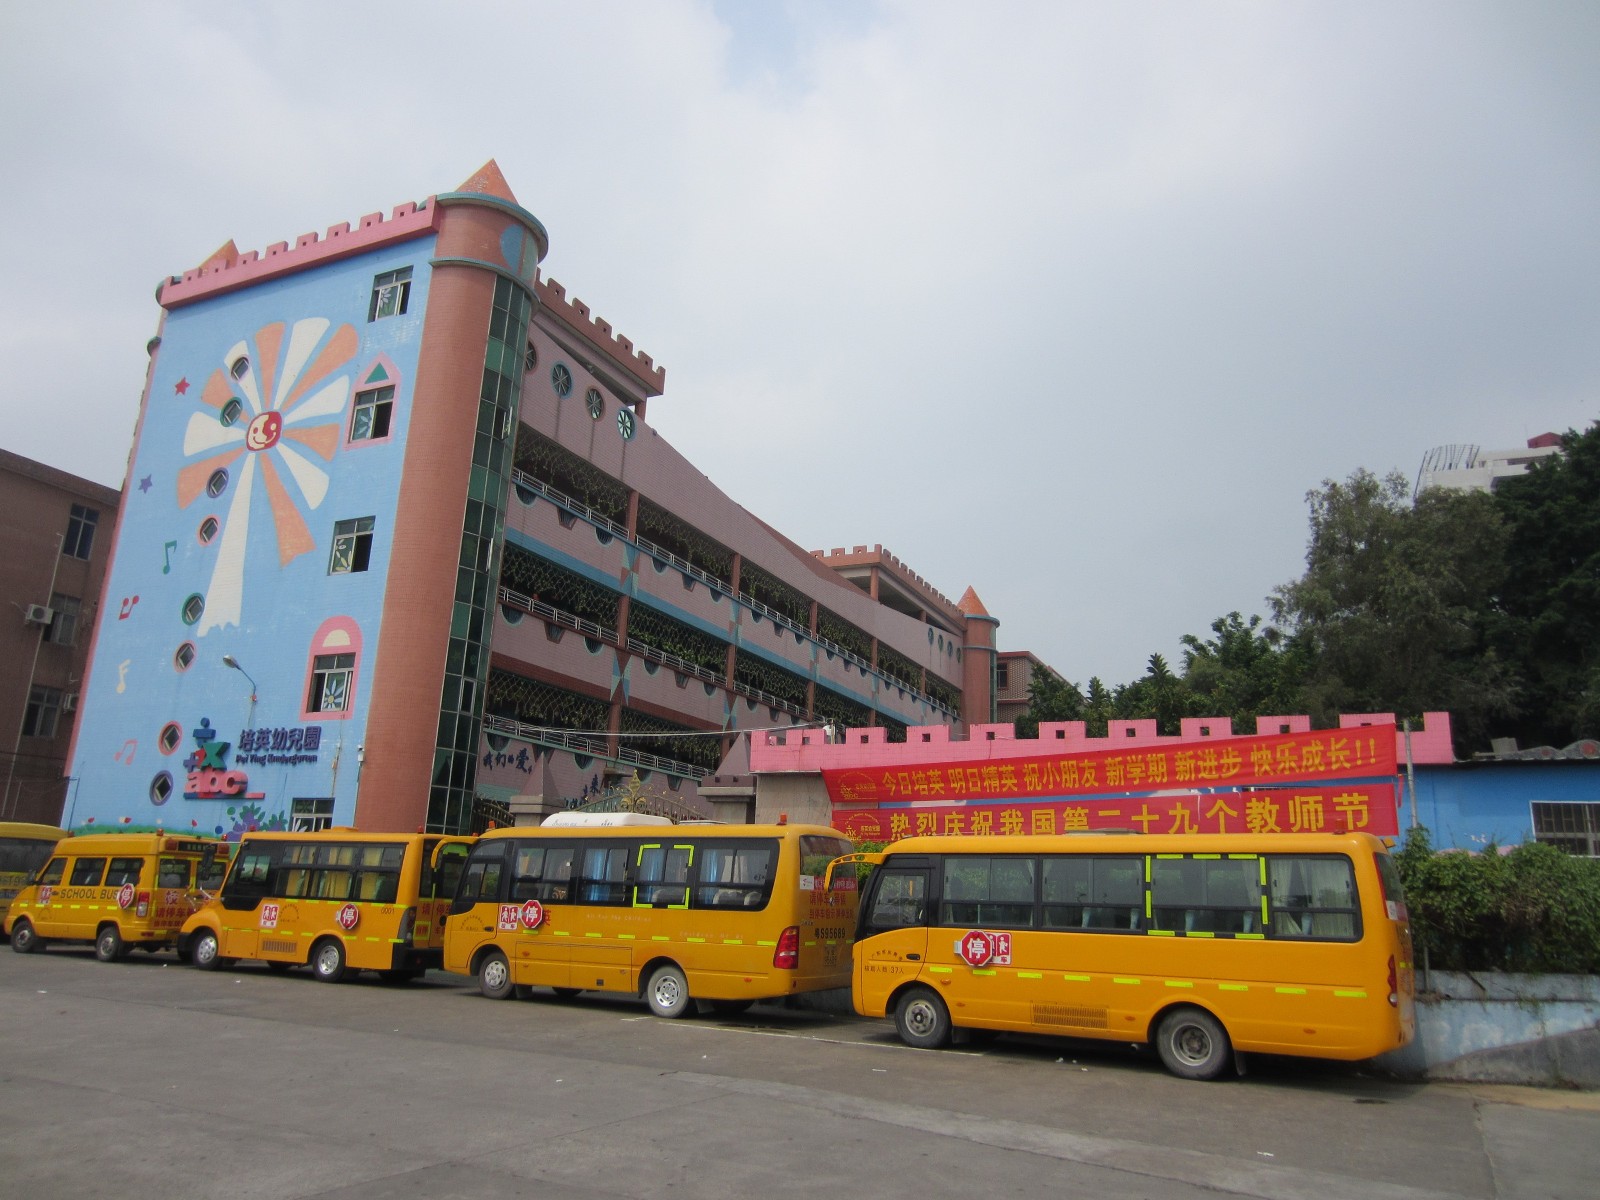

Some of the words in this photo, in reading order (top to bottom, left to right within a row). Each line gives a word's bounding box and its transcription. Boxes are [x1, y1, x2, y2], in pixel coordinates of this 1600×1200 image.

[238, 726, 321, 752] 培英幼兒園
[882, 770, 945, 796] 今日培英
[948, 765, 1018, 794] 明日精英
[1023, 759, 1099, 791] 祝小朋友
[1104, 752, 1168, 786] 新学期
[1174, 746, 1243, 781] 新进步
[60, 888, 96, 900] SCHOOL
[100, 889, 118, 900] BUS
[343, 907, 355, 925] 停
[525, 905, 538, 923] 停
[967, 937, 986, 959] 停
